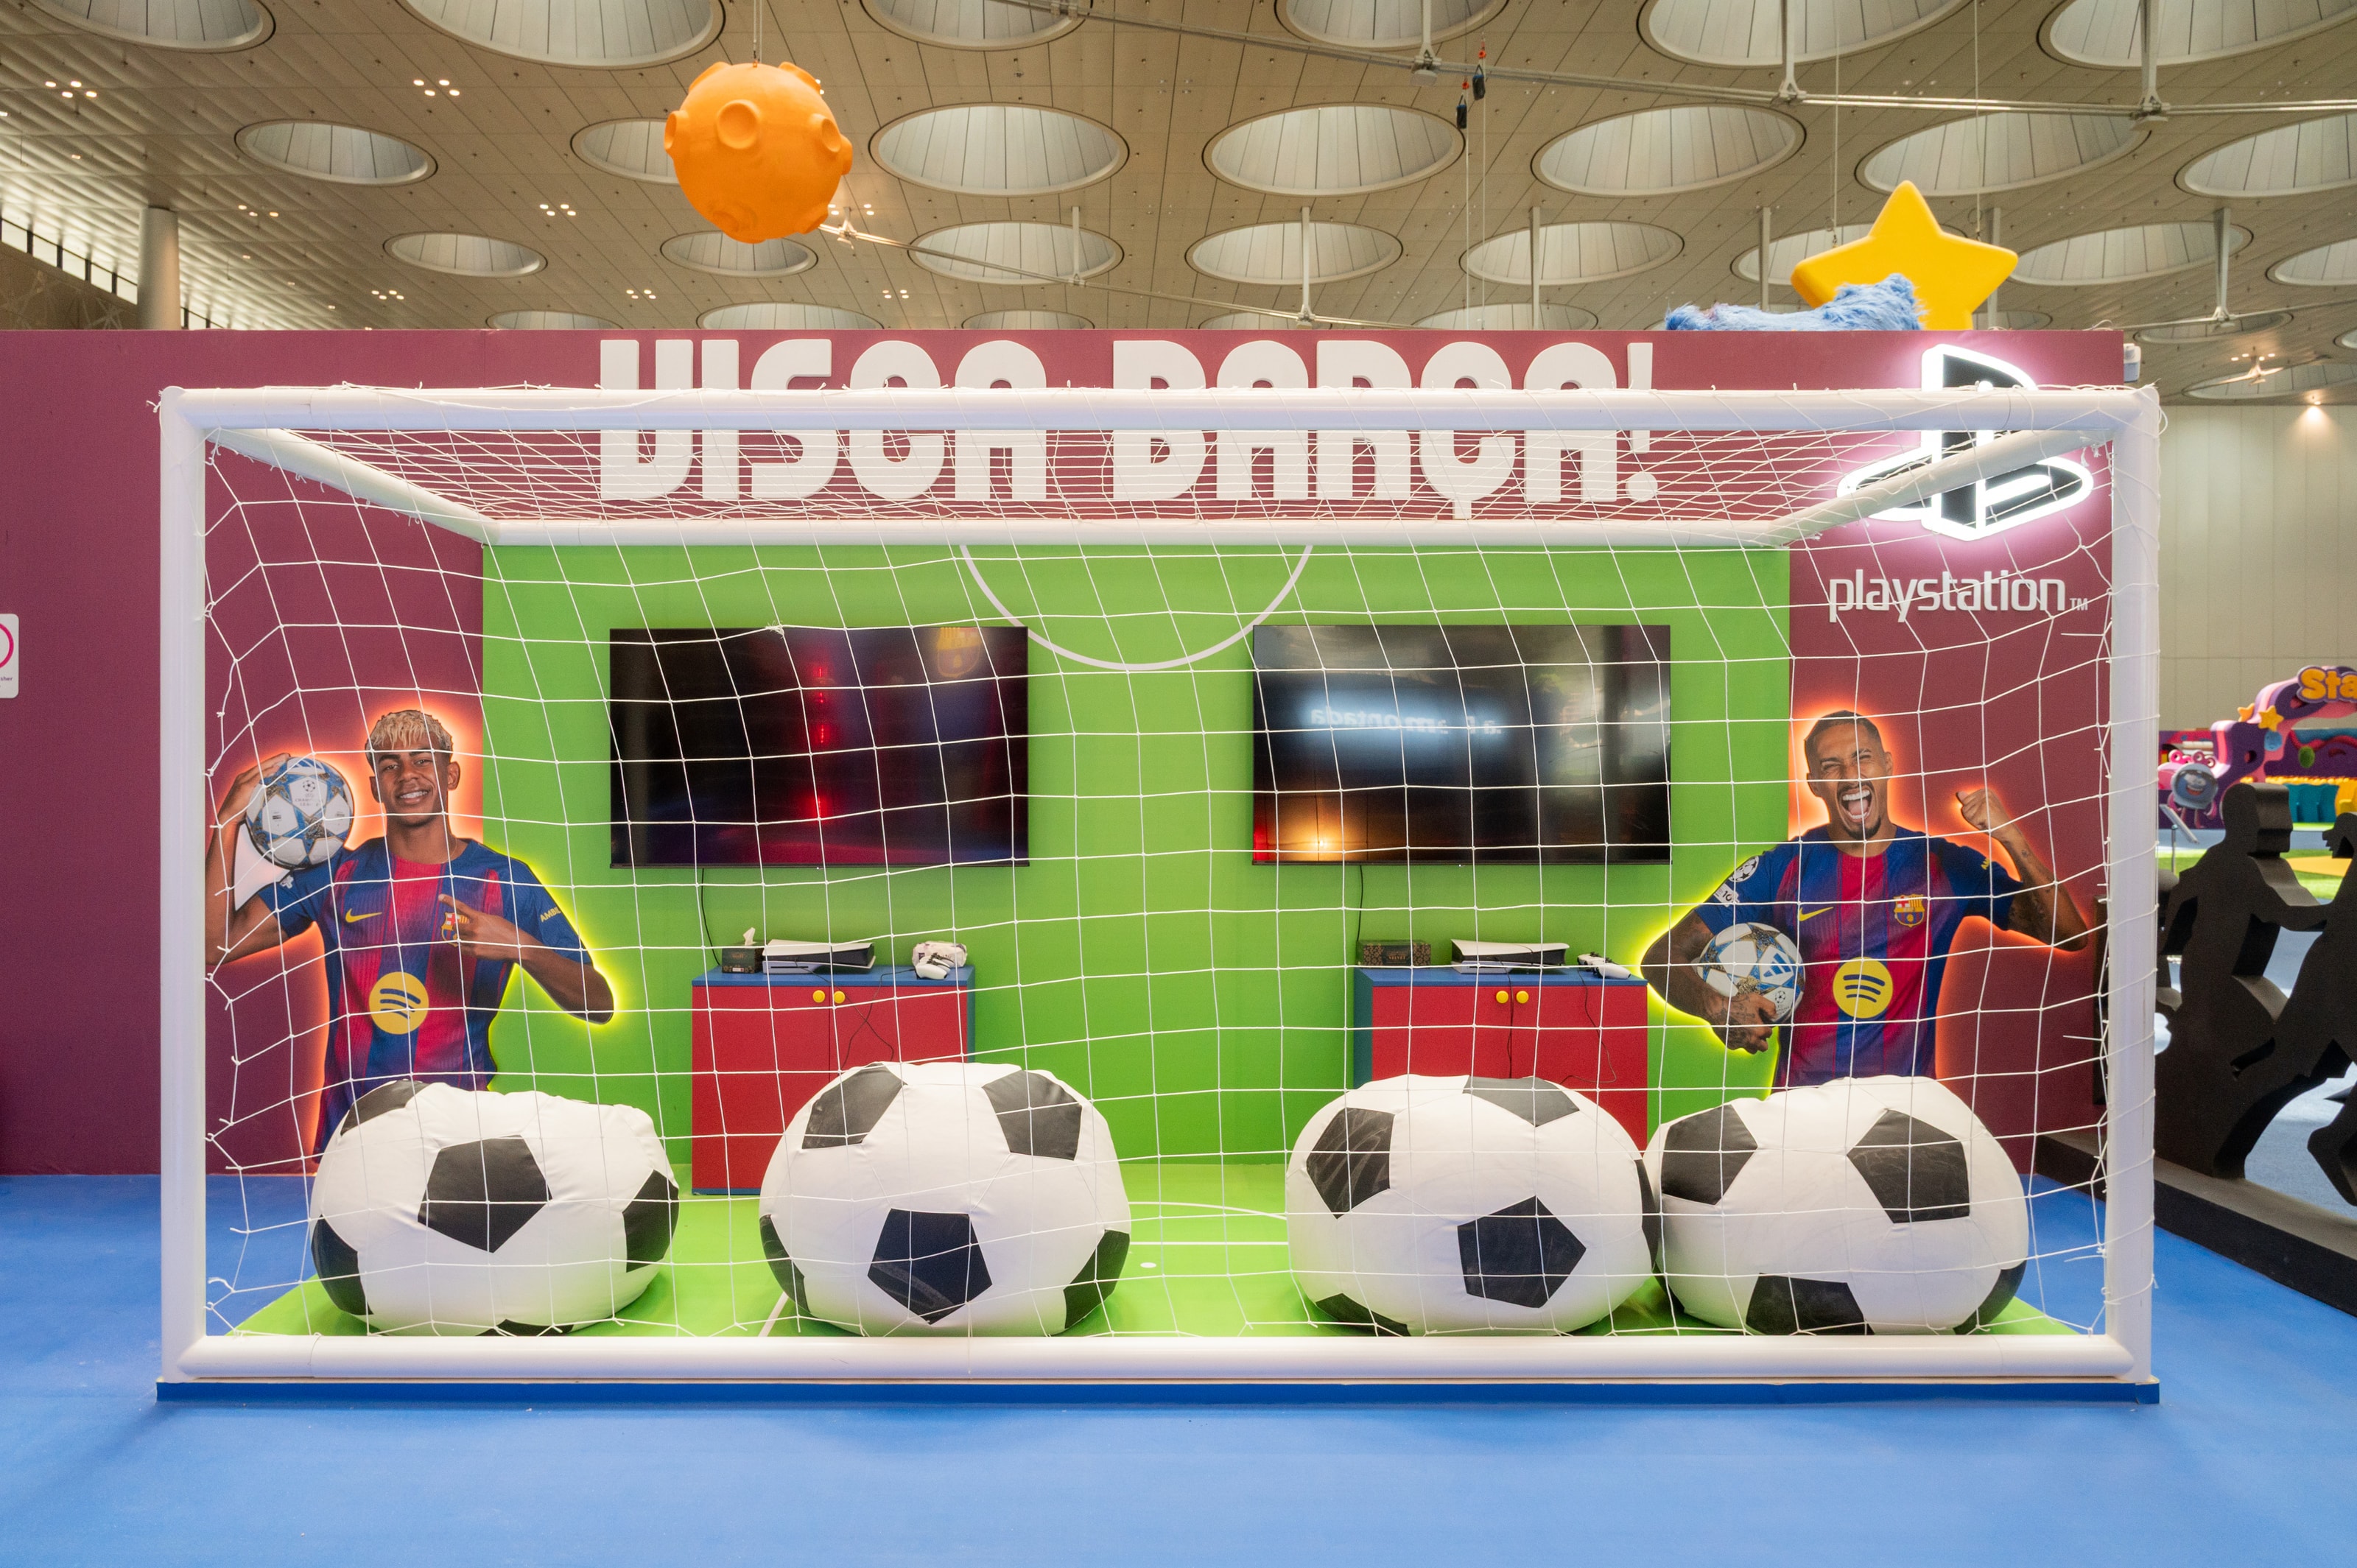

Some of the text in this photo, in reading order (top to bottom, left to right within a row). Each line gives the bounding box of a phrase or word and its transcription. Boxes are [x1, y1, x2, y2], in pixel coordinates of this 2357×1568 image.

[600, 340, 1659, 519] VISCA BARÇA!
[1830, 569, 2066, 622] playstation
